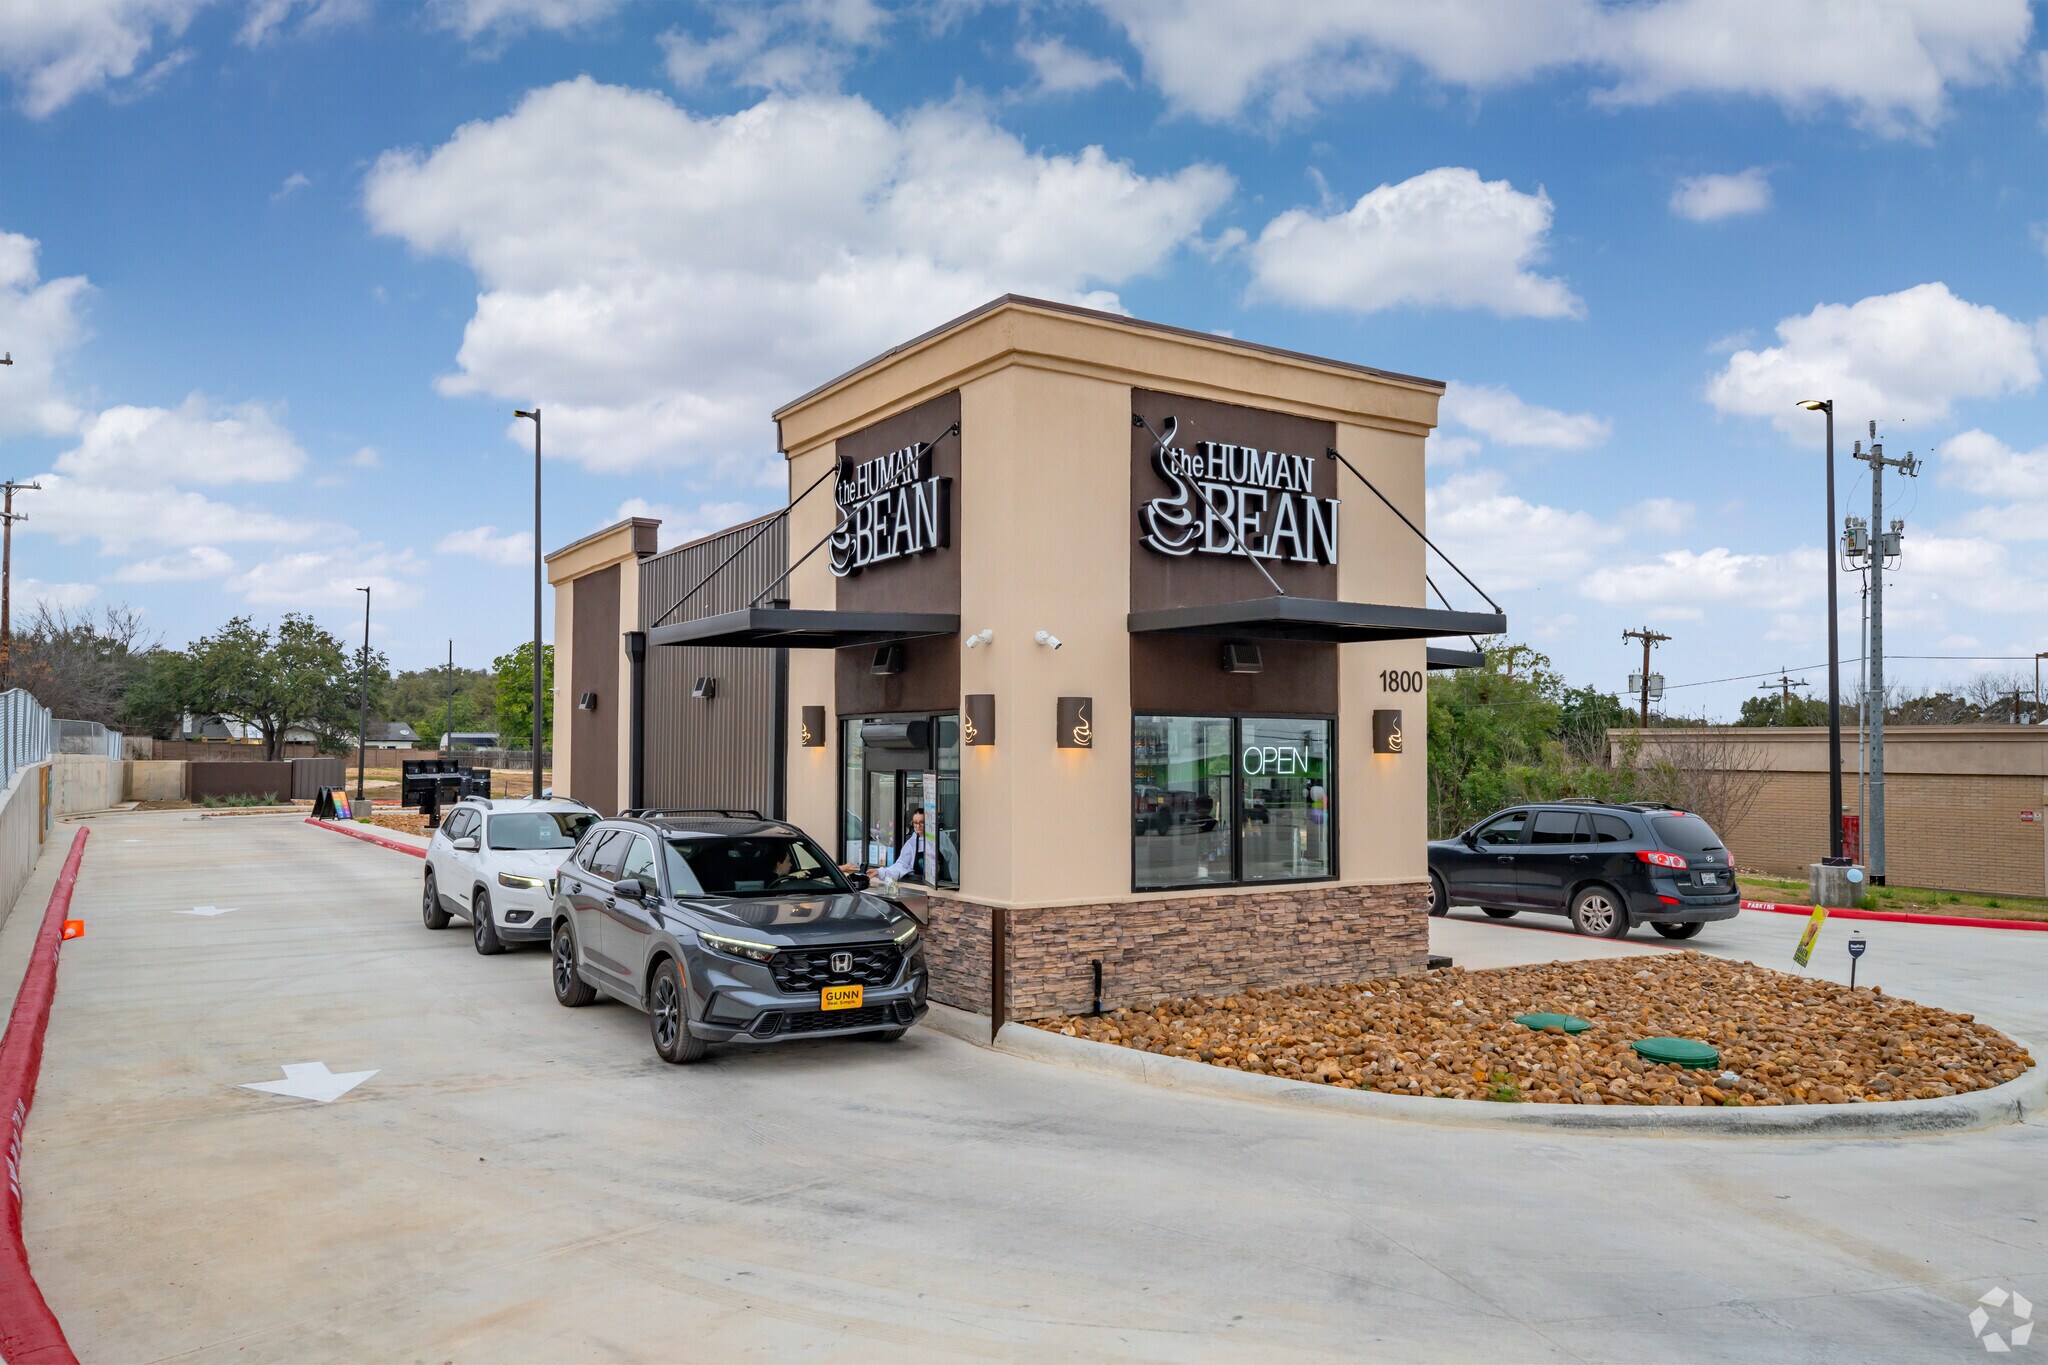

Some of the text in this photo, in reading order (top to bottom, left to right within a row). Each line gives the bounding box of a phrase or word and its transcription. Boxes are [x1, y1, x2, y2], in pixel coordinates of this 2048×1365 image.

[838, 442, 921, 505] the HUMAN
[1171, 441, 1315, 493] the HUMAN
[853, 476, 940, 568] BEAN
[1198, 481, 1341, 565] BEAN
[1379, 670, 1423, 693] 1800
[1243, 746, 1309, 775] OPEN
[1747, 902, 1775, 911] PARKING
[825, 990, 859, 1001] GUNN
